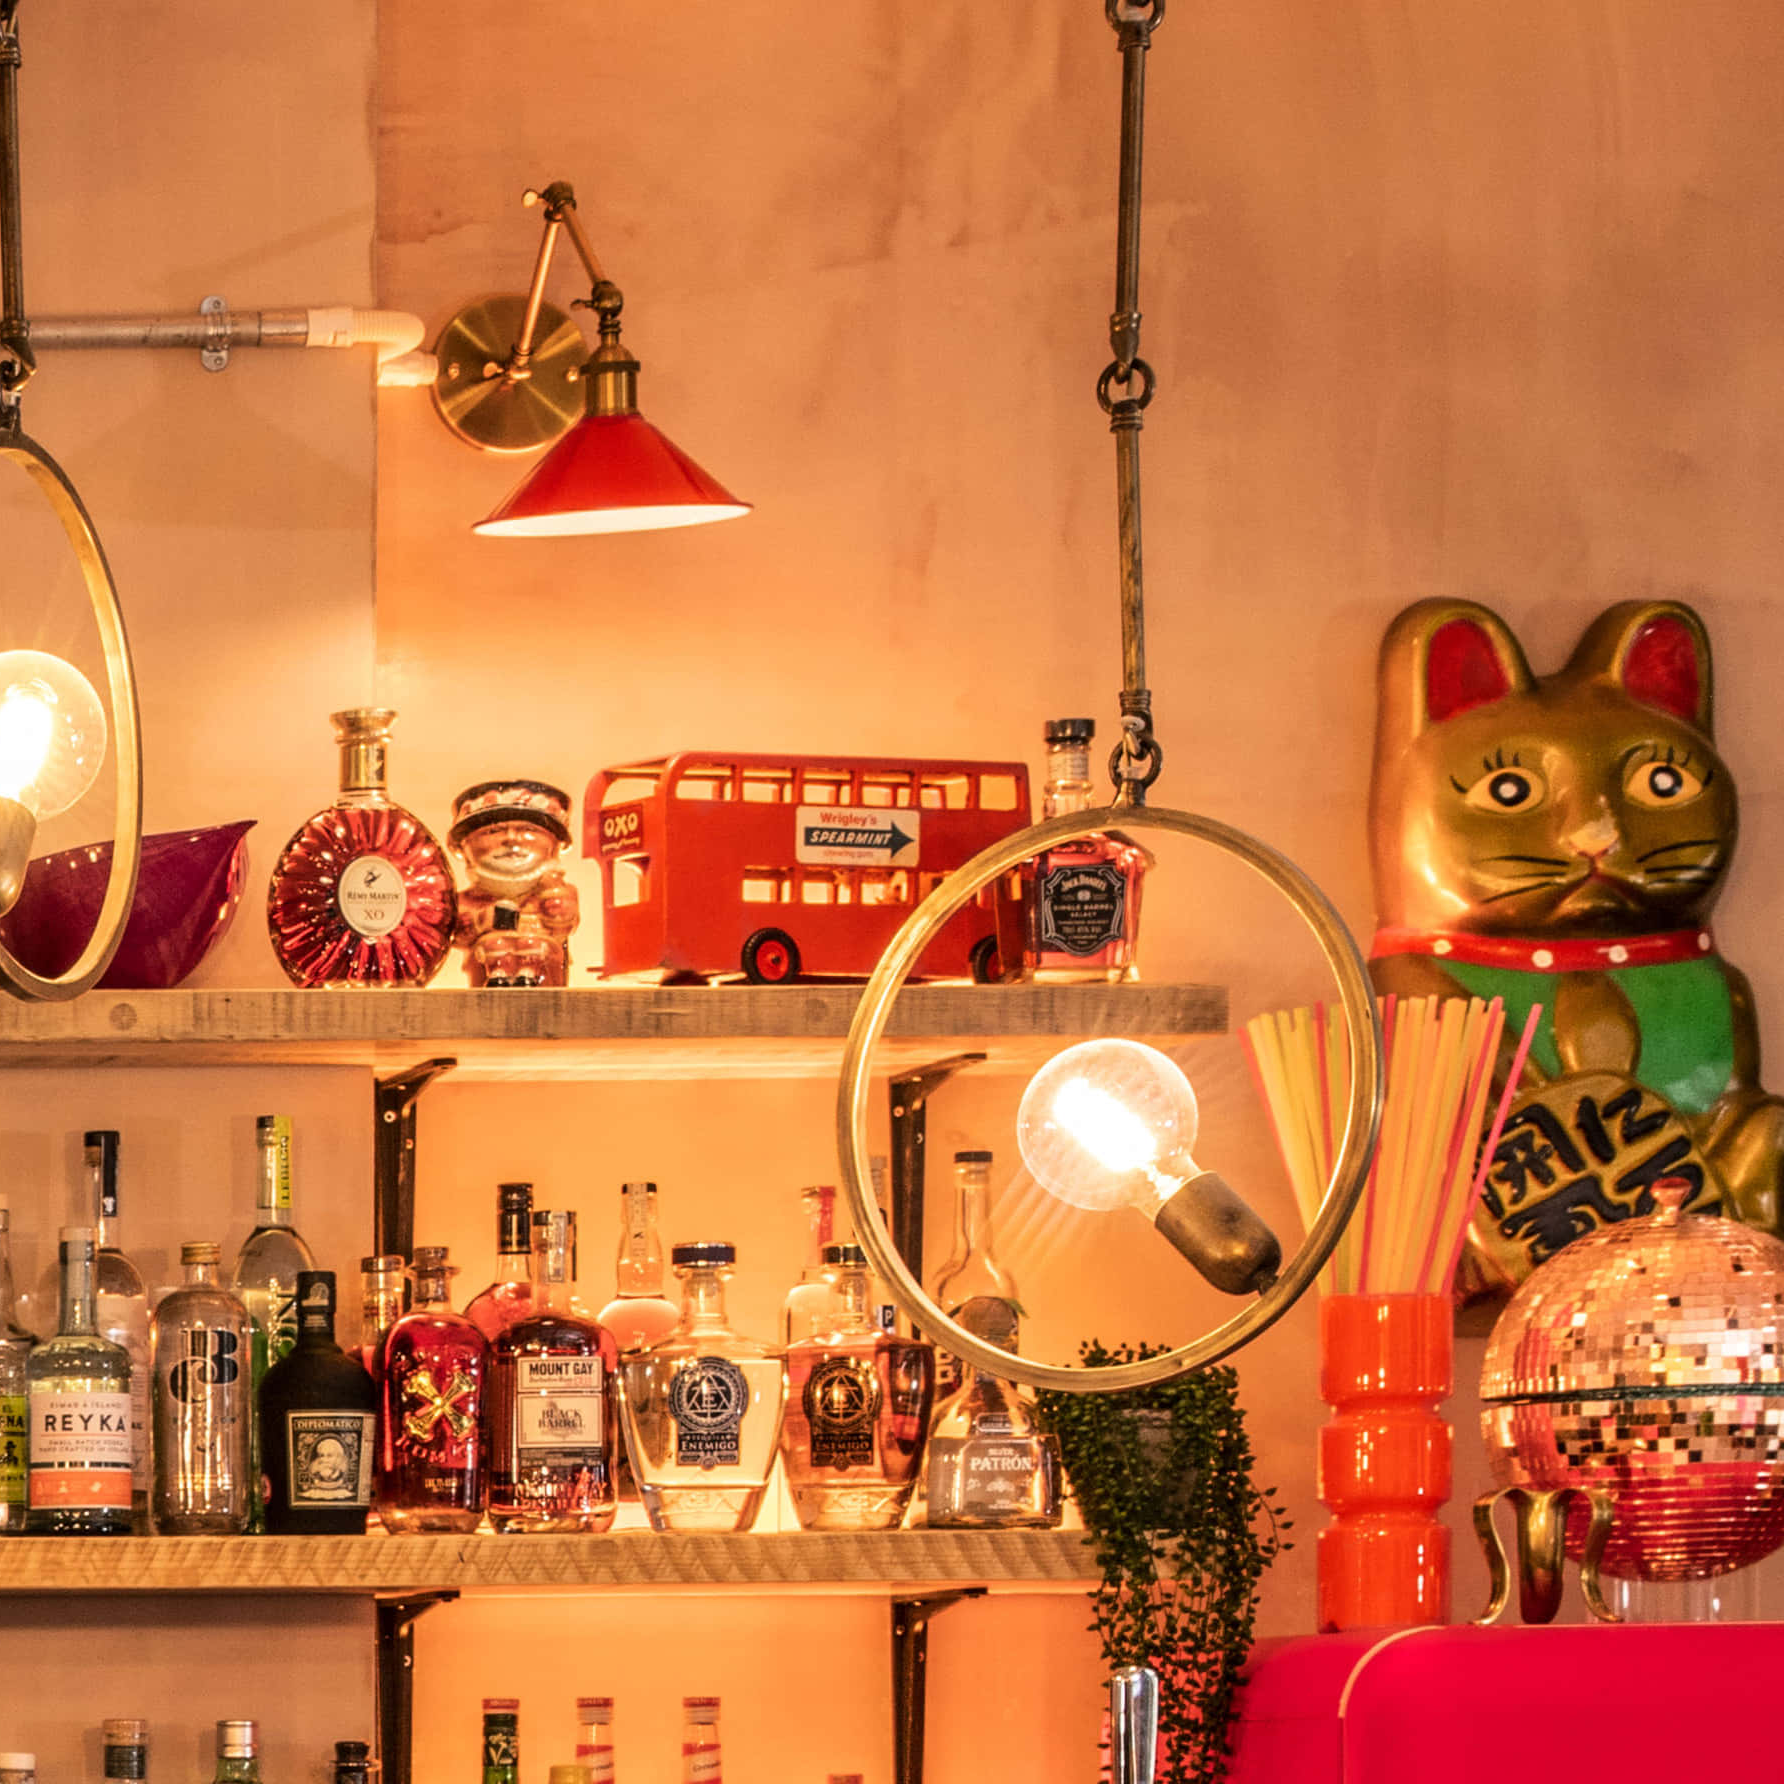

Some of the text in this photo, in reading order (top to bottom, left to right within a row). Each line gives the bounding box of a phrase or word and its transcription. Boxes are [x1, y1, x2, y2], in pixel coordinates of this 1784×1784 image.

[604, 812, 638, 837] OXO
[820, 811, 877, 827] Wrigley's
[809, 829, 892, 847] SPEARMINT
[363, 908, 385, 921] XO
[528, 1362, 594, 1376] MOUNT GAY
[542, 1408, 583, 1420] BLACK
[44, 1413, 127, 1433] REYKA
[538, 1418, 586, 1430] BARREL
[681, 1440, 737, 1451] ENEMIGO
[969, 1455, 1033, 1472] PATRÓN
